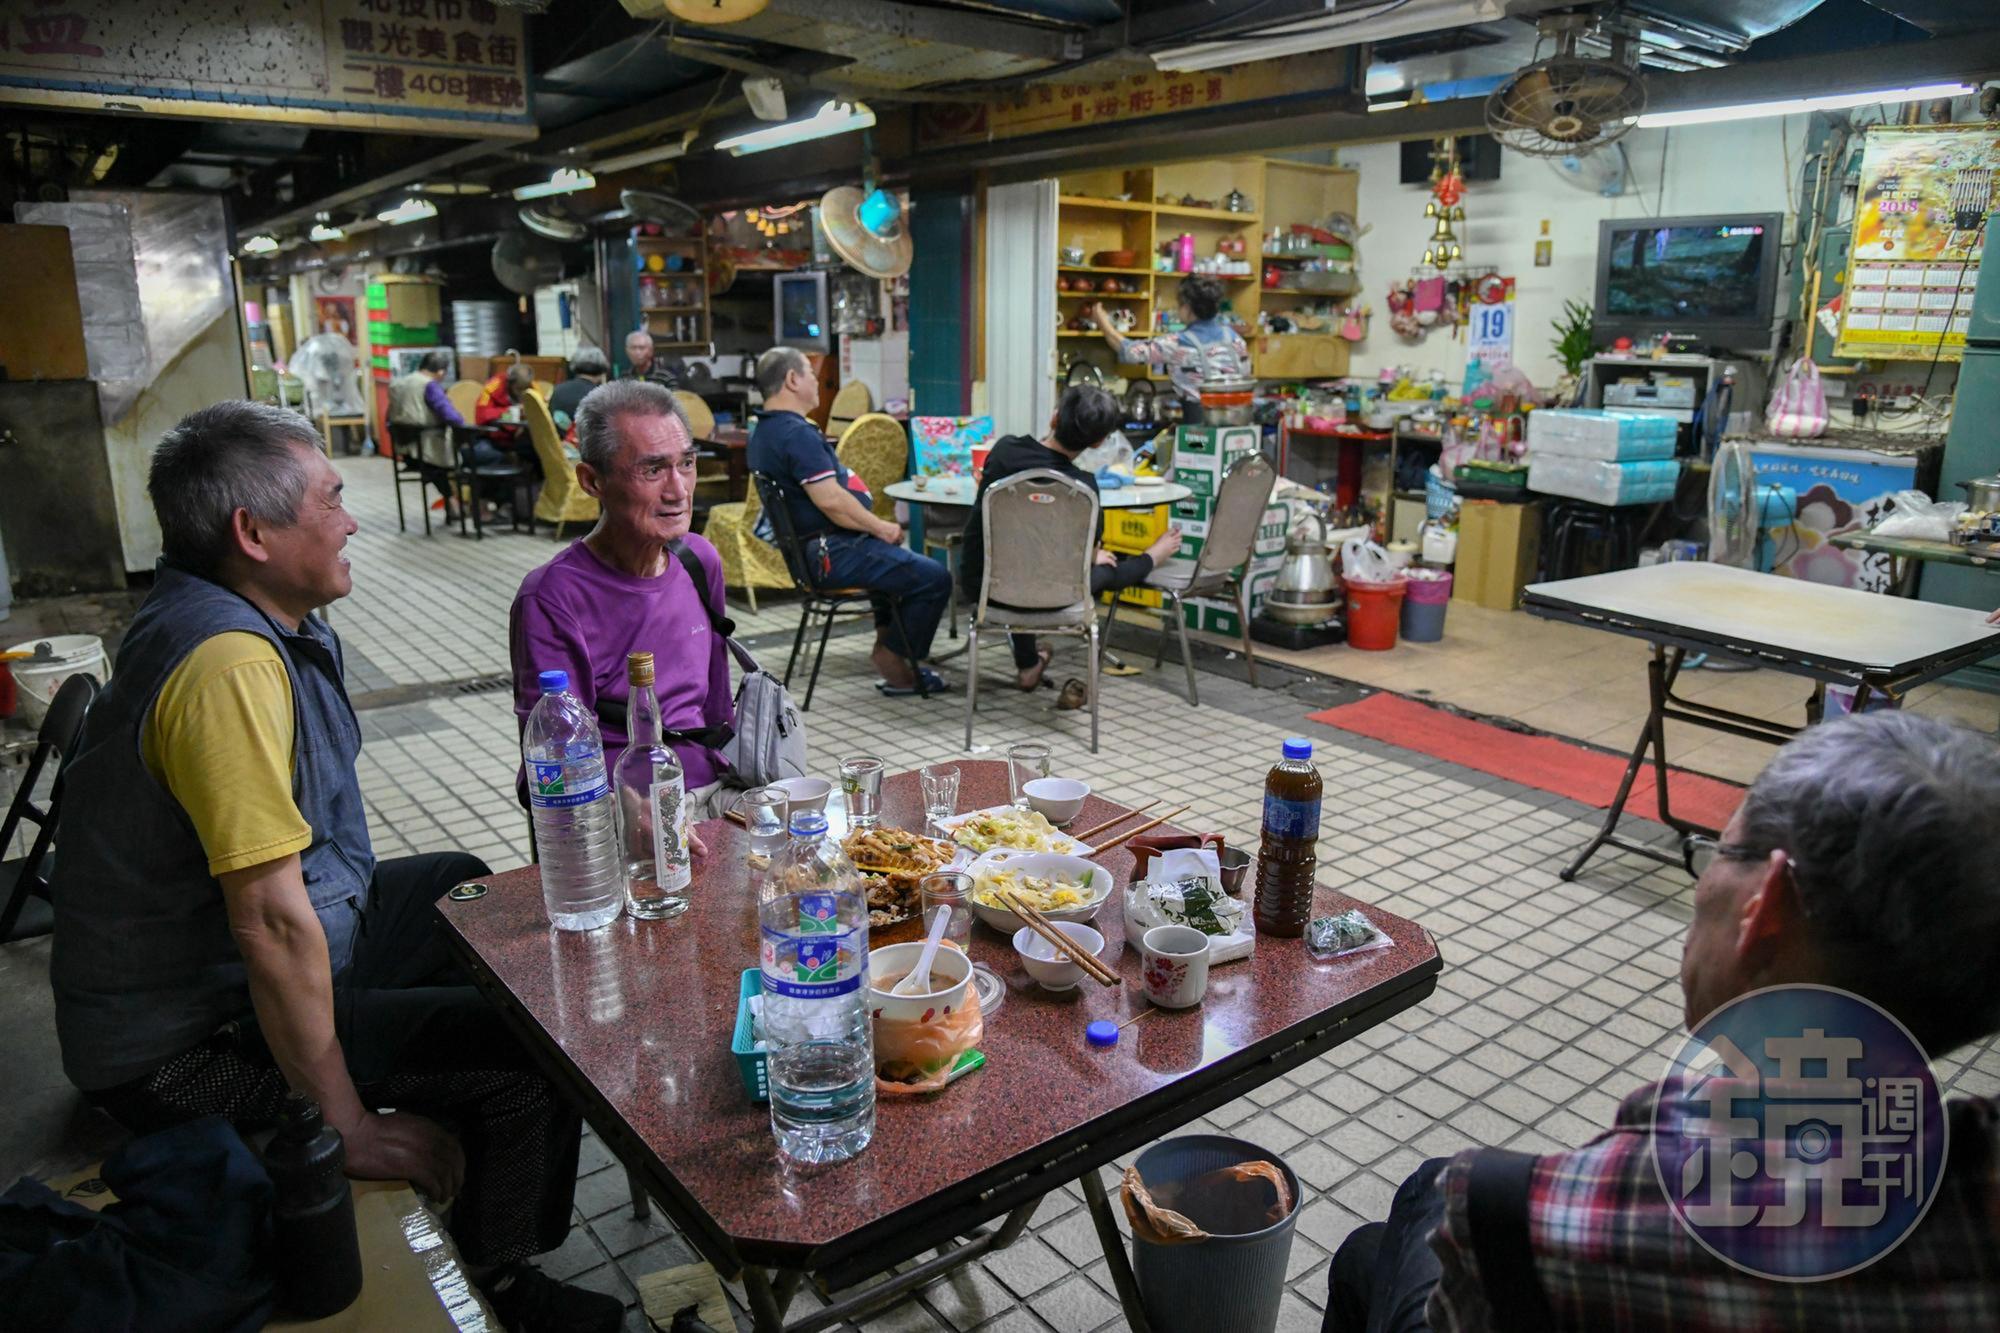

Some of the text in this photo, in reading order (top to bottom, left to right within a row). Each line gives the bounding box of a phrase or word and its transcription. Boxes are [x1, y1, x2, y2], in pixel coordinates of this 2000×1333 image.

[340, 17, 517, 66] 觀光美食街
[1879, 201, 1918, 212] 2018
[1482, 310, 1504, 338] 19
